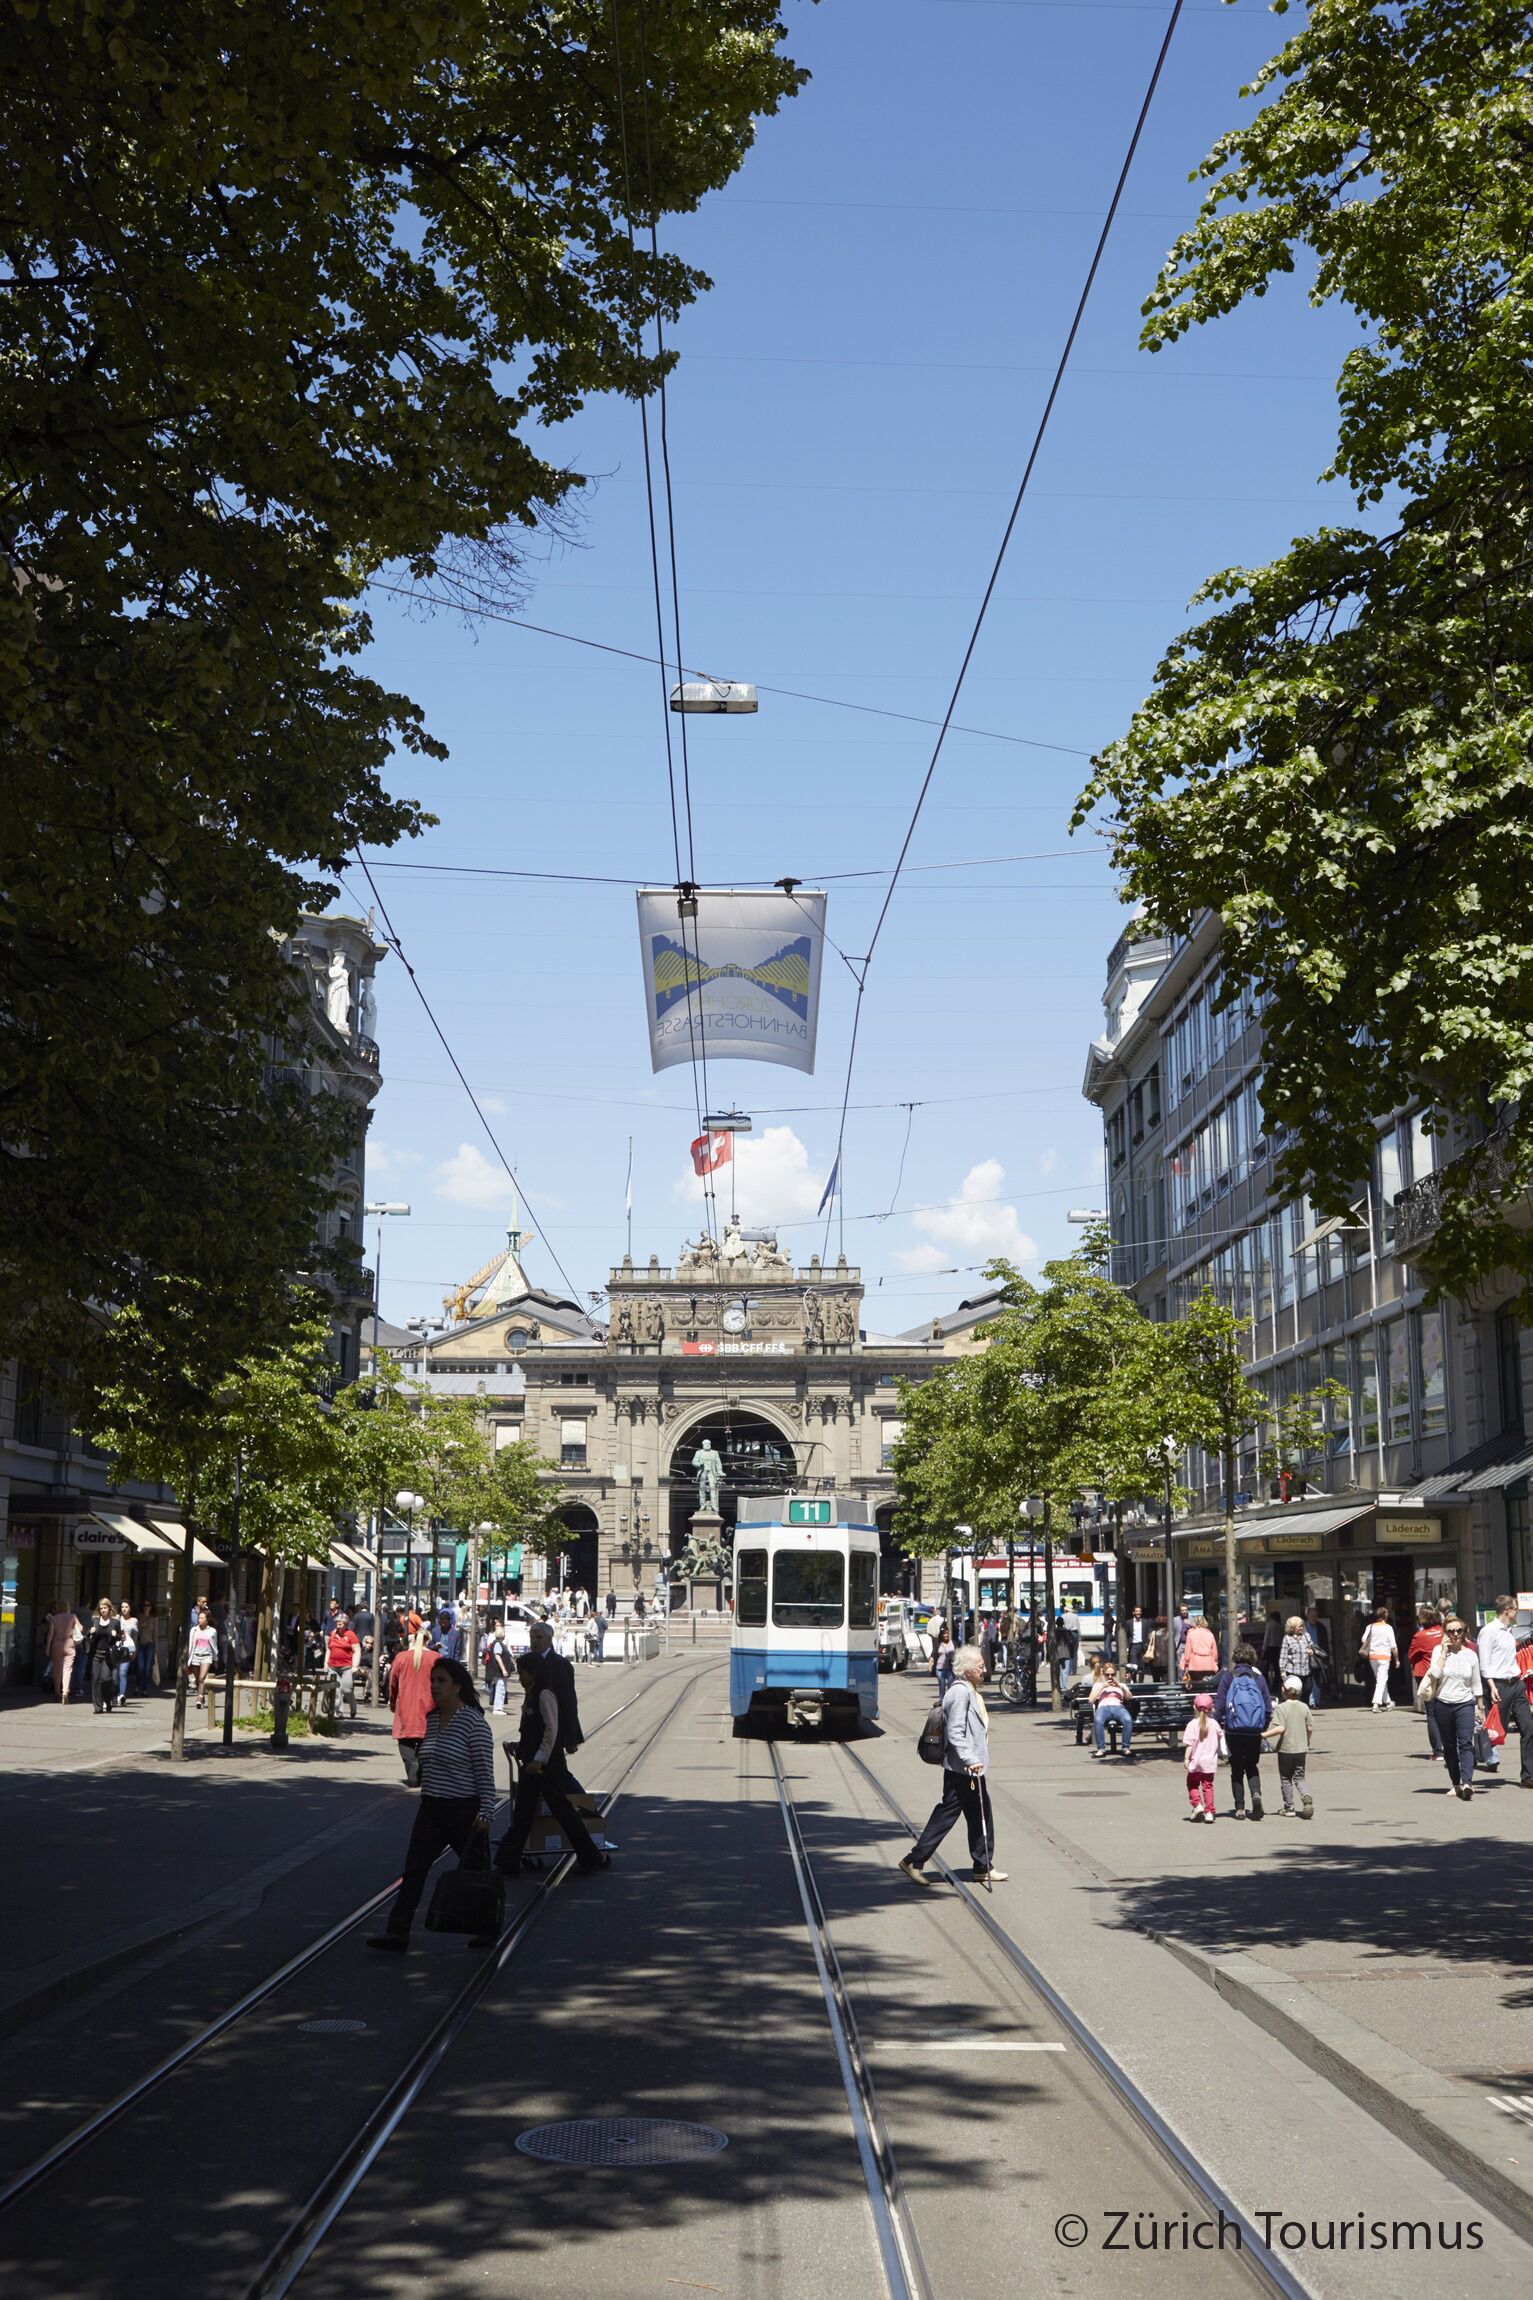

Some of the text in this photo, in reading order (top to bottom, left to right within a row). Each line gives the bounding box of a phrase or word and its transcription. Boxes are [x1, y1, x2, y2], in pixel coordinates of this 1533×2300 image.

[717, 1342, 785, 1353] SBB CFF FFS
[800, 1502, 819, 1520] 11
[1386, 1523, 1430, 1533] Läderach
